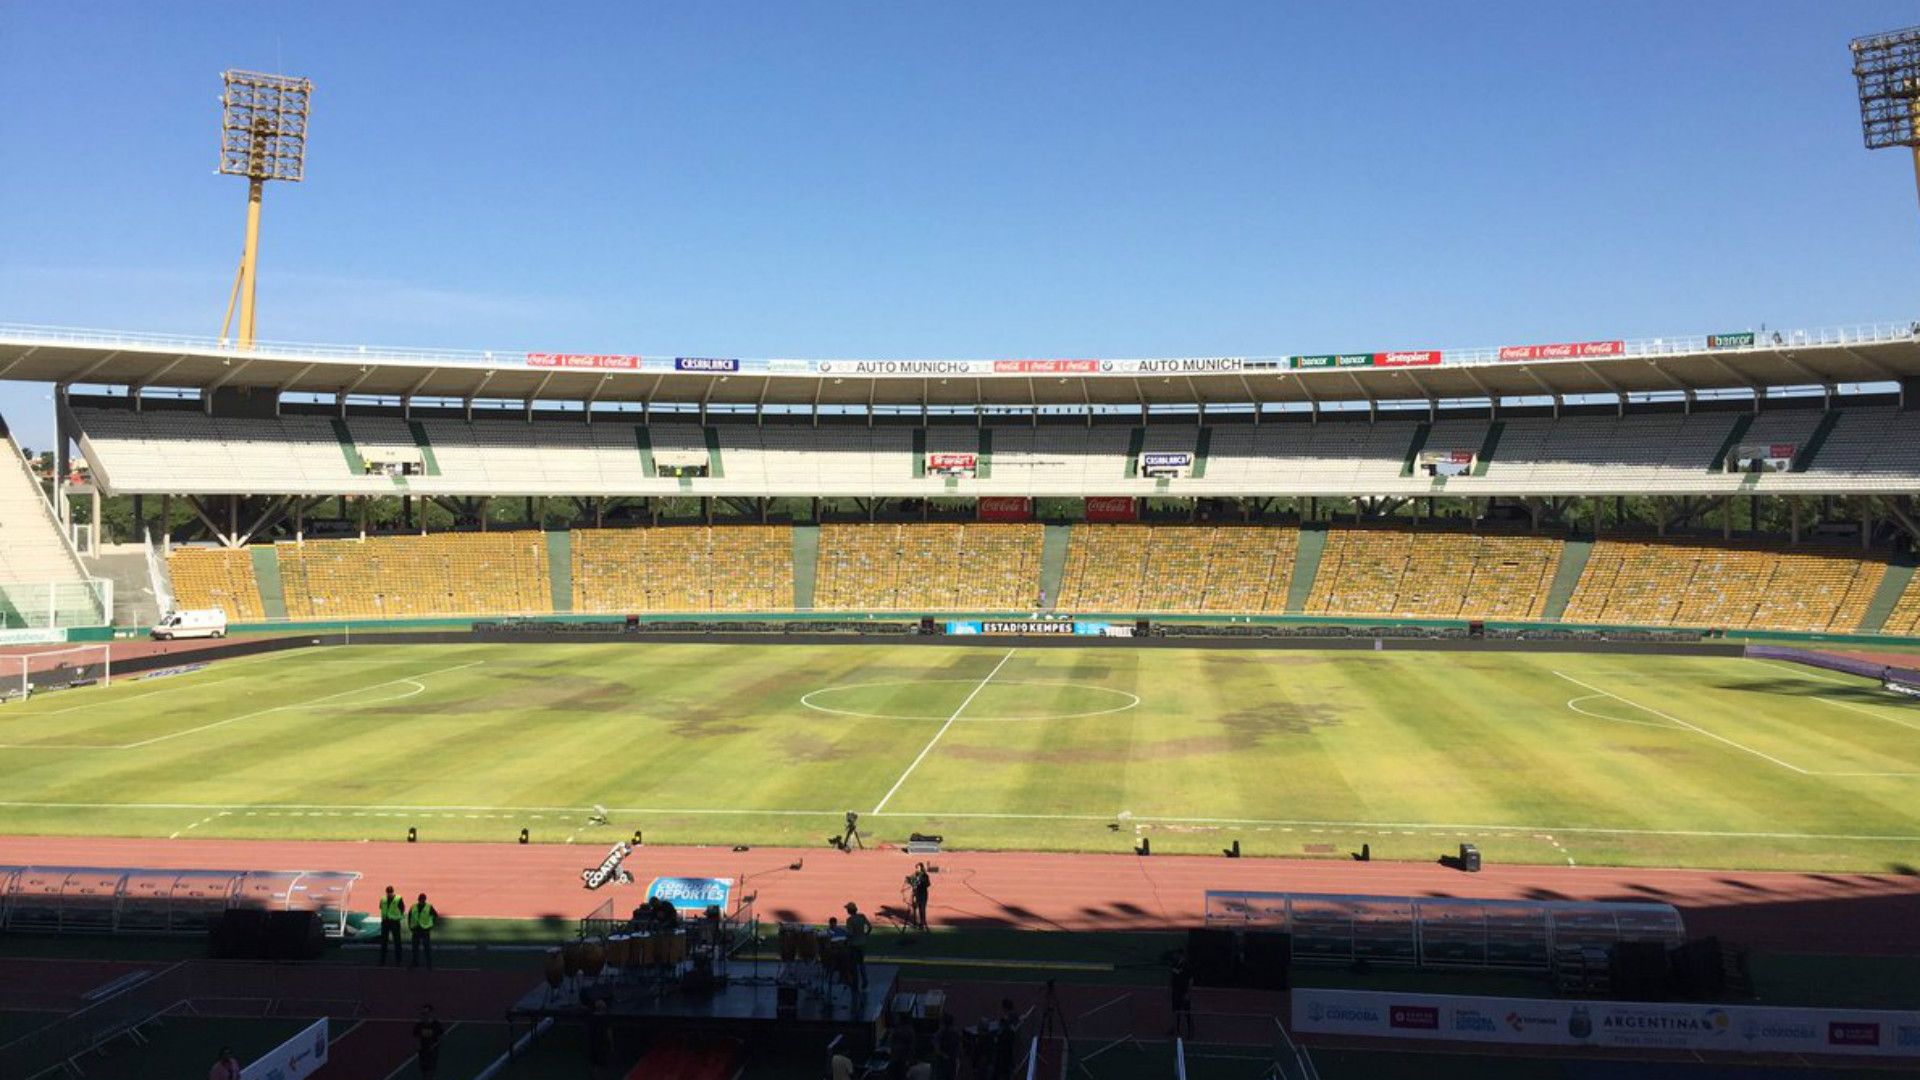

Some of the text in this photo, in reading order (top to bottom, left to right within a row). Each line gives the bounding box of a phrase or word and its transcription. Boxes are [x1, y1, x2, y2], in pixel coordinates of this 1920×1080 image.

[856, 361, 897, 373] AUTO
[900, 361, 958, 373] MUNICH
[1138, 360, 1179, 372] AUTO
[1182, 358, 1241, 371] MUNICH
[983, 622, 1027, 633] ESTADIO
[1029, 622, 1073, 633] KEMPES
[655, 889, 725, 901] DEPORTES
[1603, 1015, 1699, 1030] ARGENTINA
